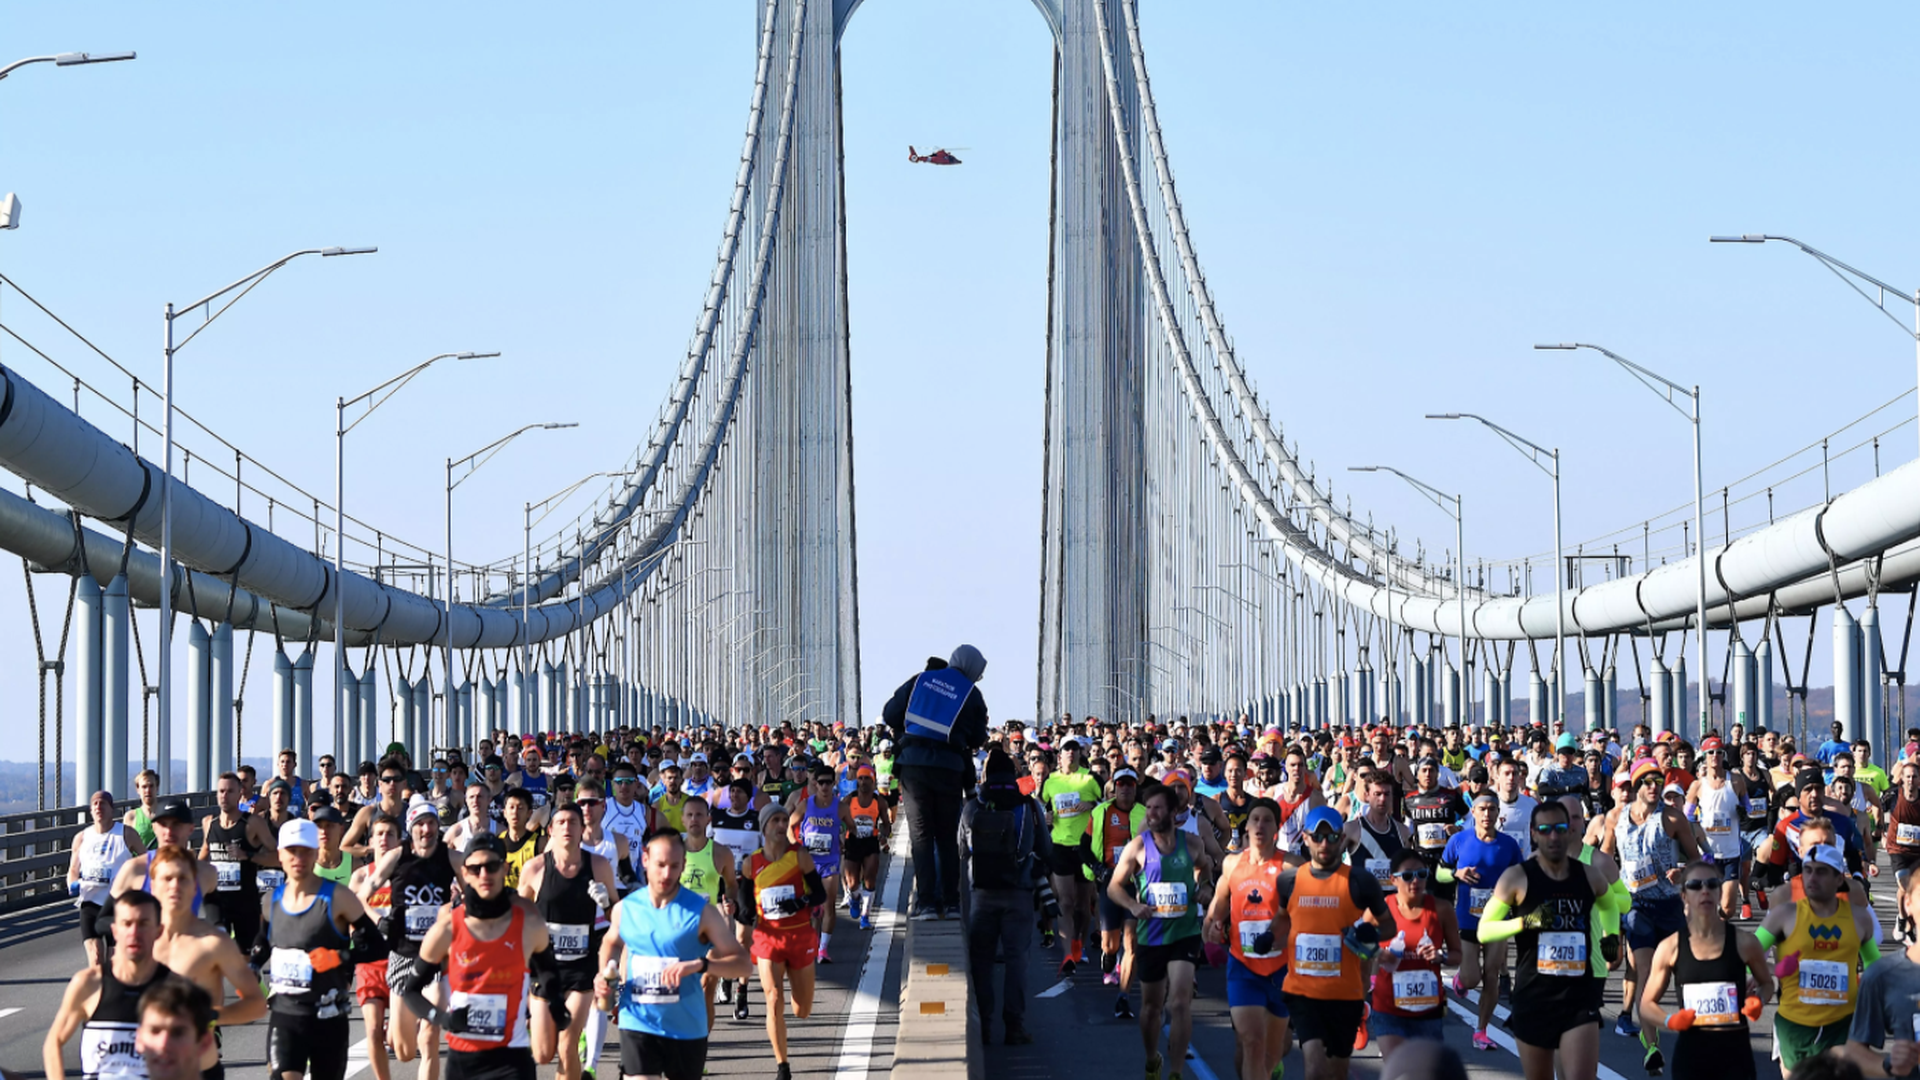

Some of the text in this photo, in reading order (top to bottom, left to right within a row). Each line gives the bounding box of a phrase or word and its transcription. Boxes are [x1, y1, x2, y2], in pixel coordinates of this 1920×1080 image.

[559, 935, 579, 948] 1785
[1306, 947, 1329, 961] 2361
[1550, 945, 1575, 960] 2479
[1810, 973, 1837, 990] 5026
[1406, 982, 1426, 996] 542
[1696, 997, 1725, 1014] 2336
